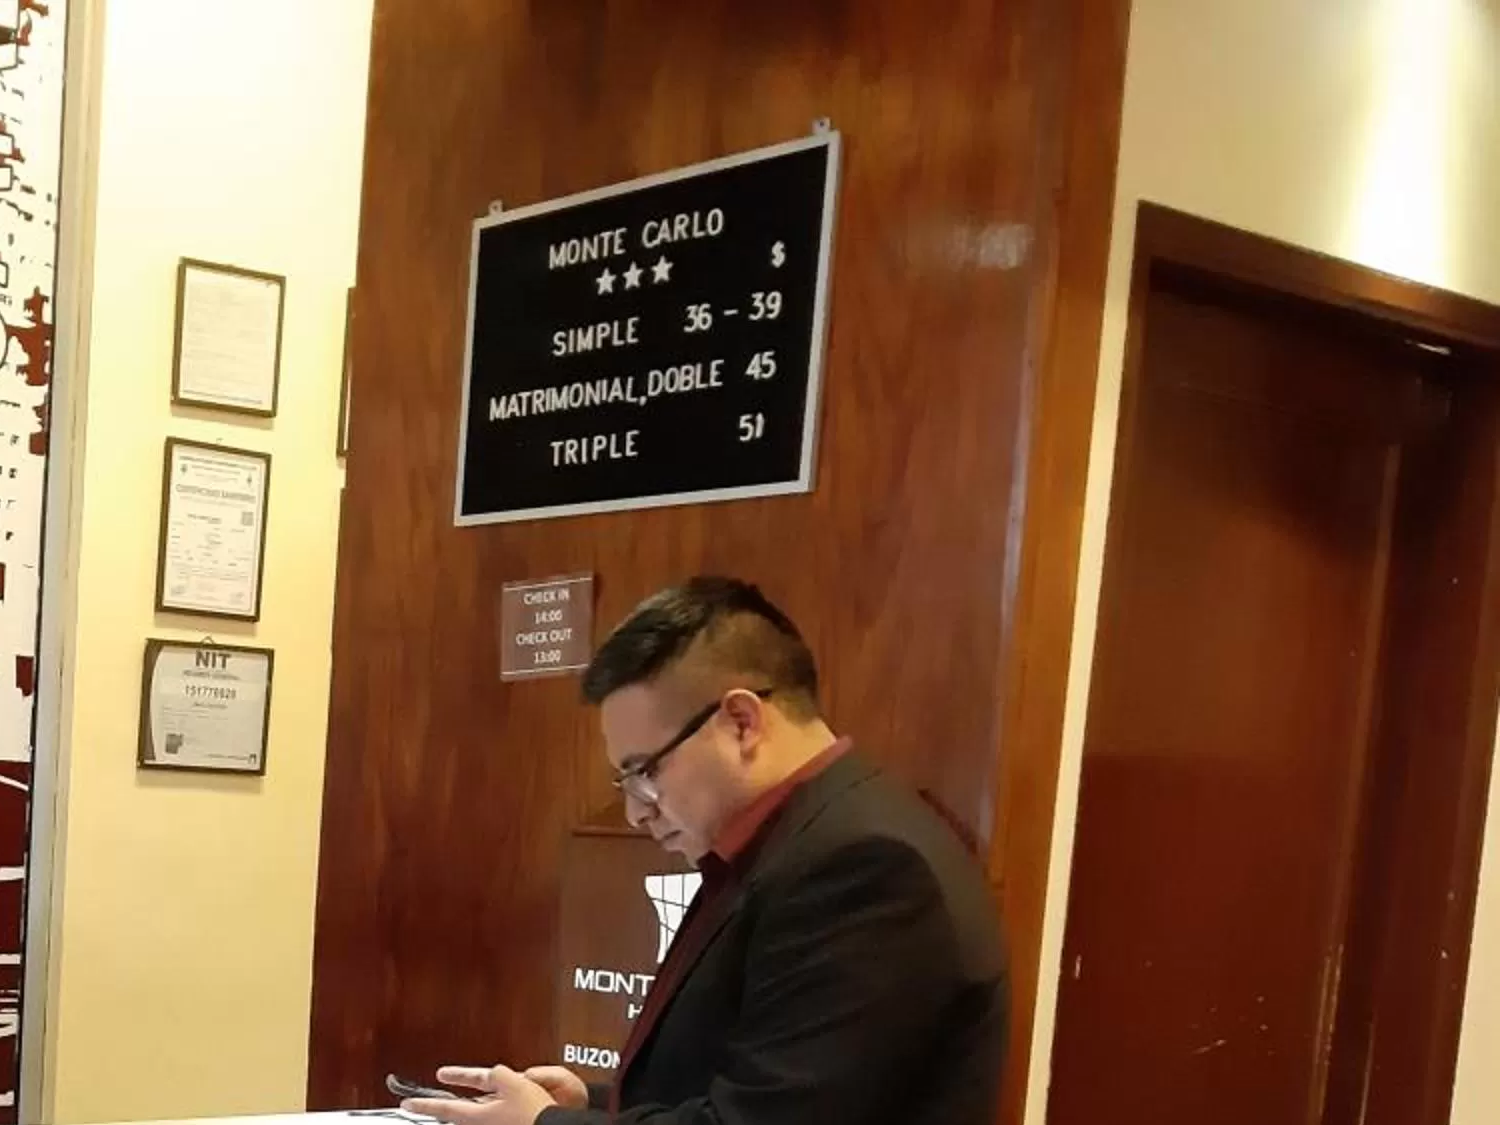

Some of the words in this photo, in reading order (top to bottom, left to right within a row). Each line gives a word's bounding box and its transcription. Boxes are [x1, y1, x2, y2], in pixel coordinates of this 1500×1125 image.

[548, 227, 628, 270] MONTE
[641, 207, 725, 249] CARLO
[771, 240, 787, 268] $
[552, 316, 640, 356] SIMPLE
[683, 303, 713, 333] 36
[748, 290, 783, 321] 39
[745, 350, 778, 381] 45
[550, 430, 640, 467] TRIPLE
[738, 412, 765, 442] 51
[195, 650, 232, 669] NIT
